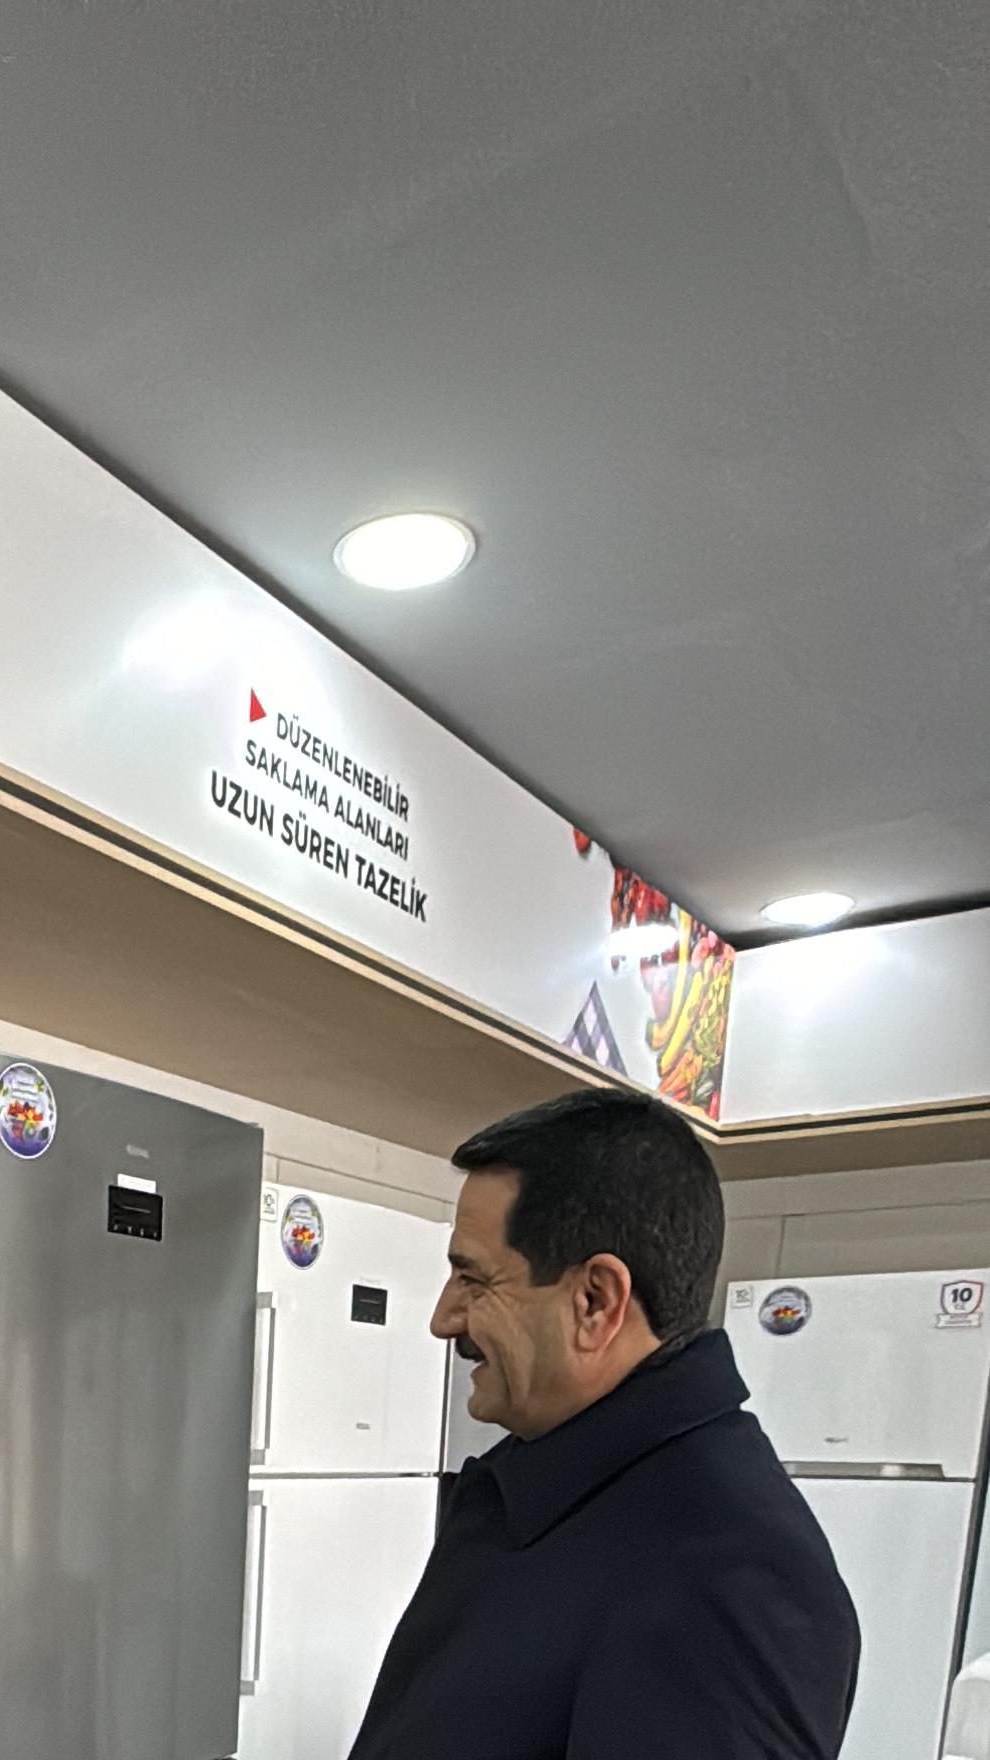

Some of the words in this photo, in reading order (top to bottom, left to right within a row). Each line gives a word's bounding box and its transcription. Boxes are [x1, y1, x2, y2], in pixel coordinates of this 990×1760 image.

[245, 739, 330, 813] SAKLAMA
[334, 795, 409, 861] ALANLARI
[276, 712, 410, 822] DÜZENLENEBİLİR
[211, 769, 274, 837] UZUN
[280, 811, 350, 879] SÜREN
[355, 853, 427, 923] TAZELİK
[952, 1287, 973, 1304] 10
